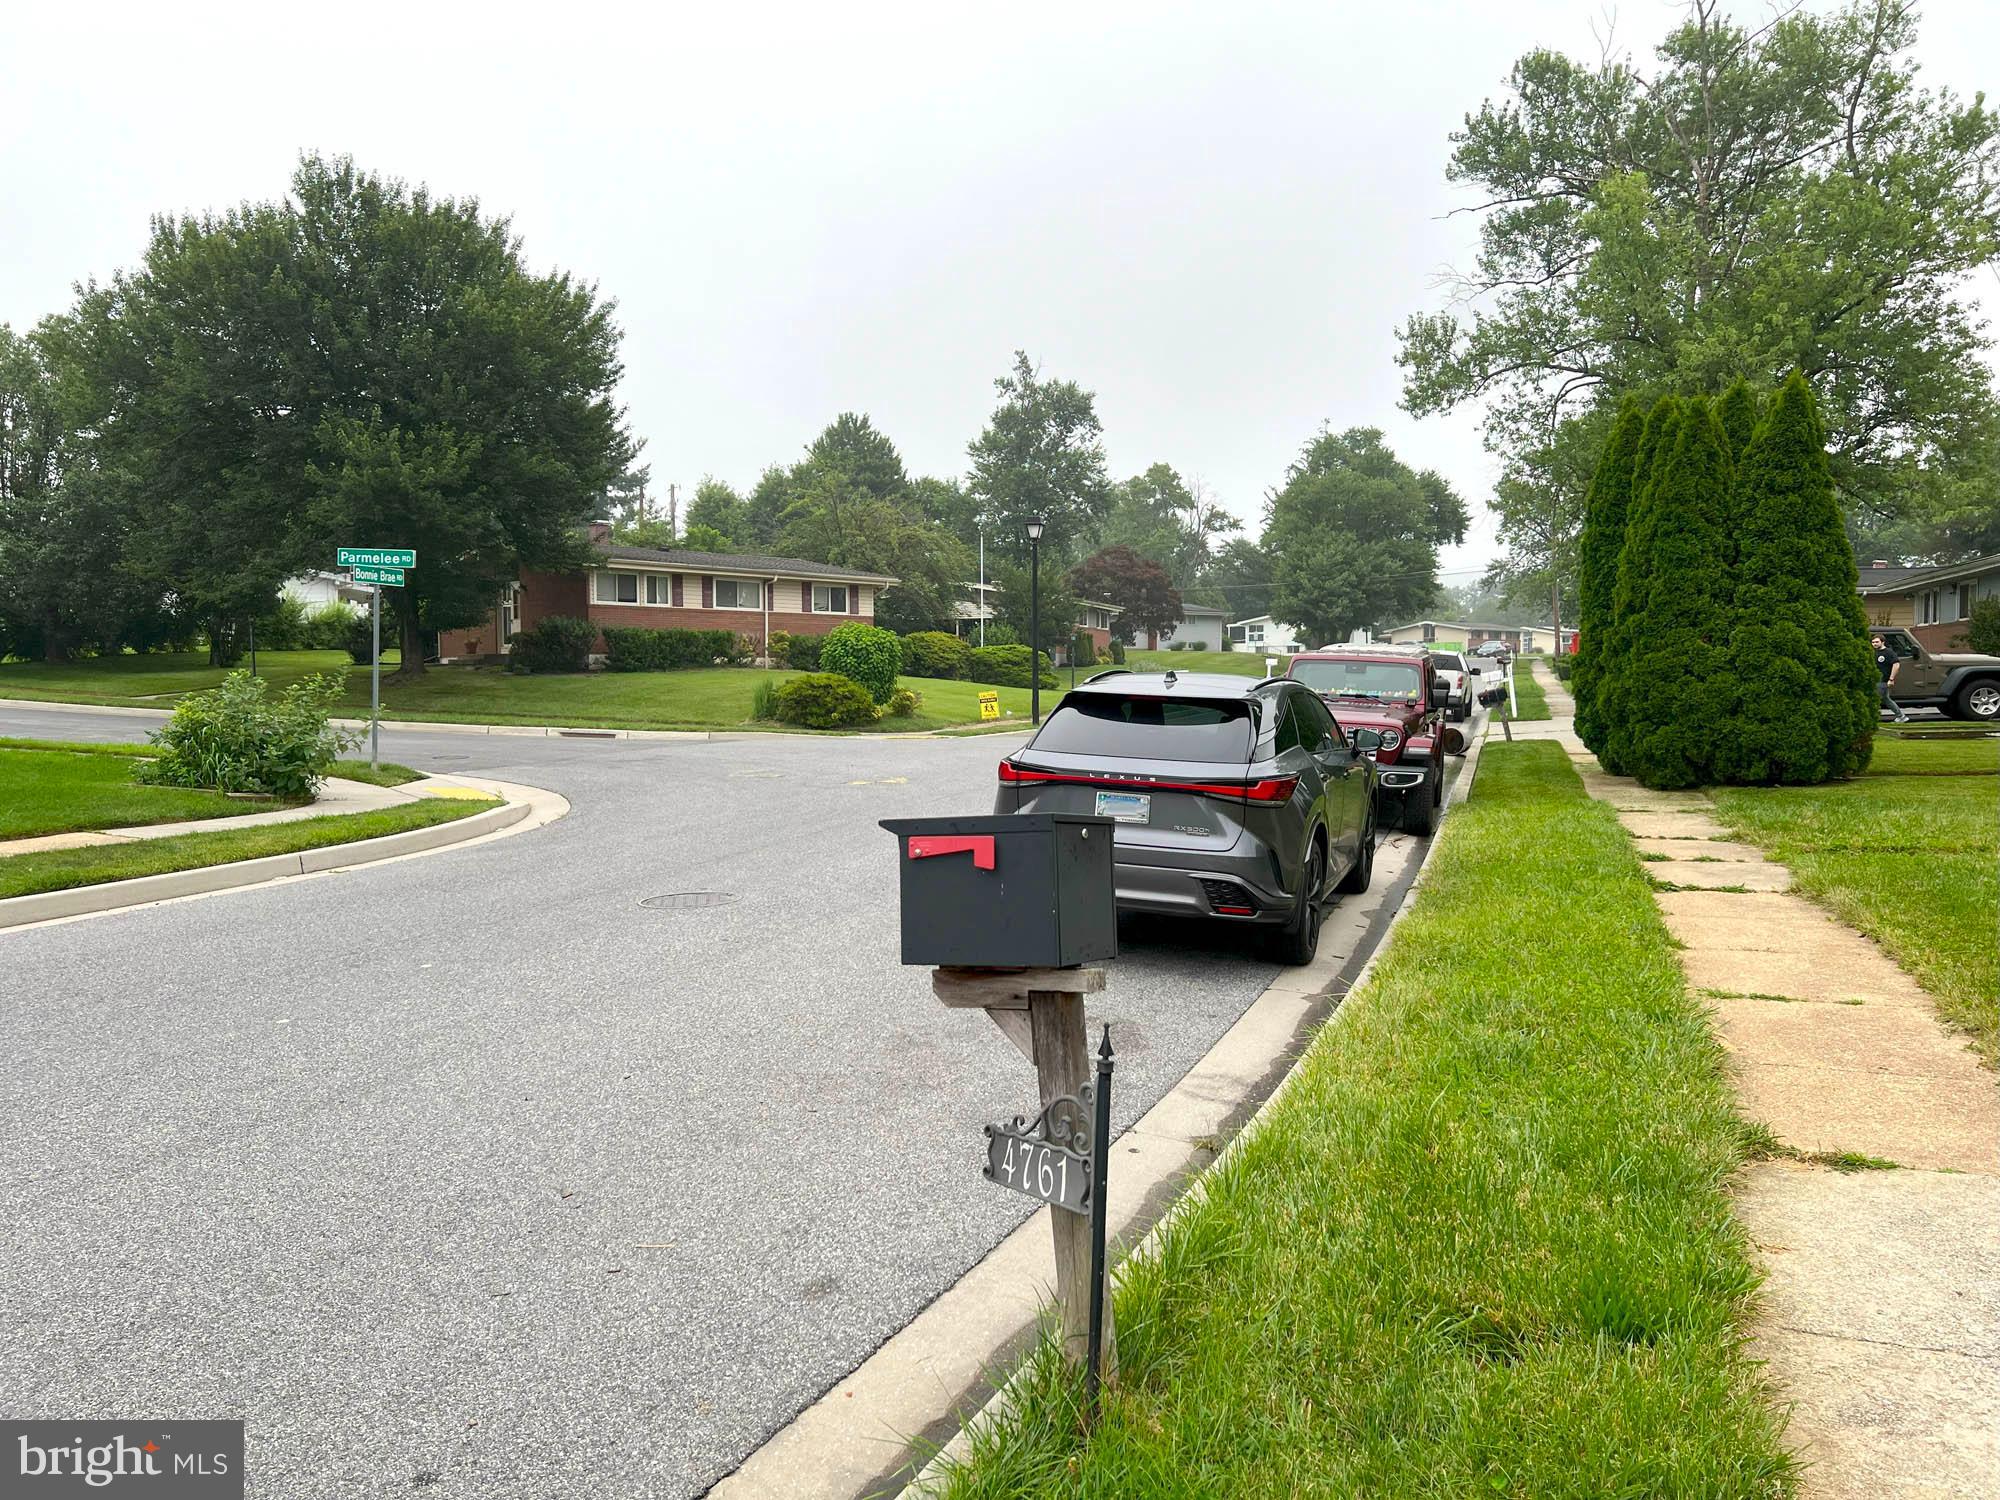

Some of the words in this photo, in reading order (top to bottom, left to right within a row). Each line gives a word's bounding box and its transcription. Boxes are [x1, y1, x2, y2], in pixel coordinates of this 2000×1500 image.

[340, 551, 400, 564] Parmelee
[401, 555, 412, 563] RD
[355, 568, 378, 581] Bonnie
[380, 570, 396, 582] Brae
[1089, 772, 1156, 782] LEXUS
[1001, 1137, 1067, 1203] 4761
